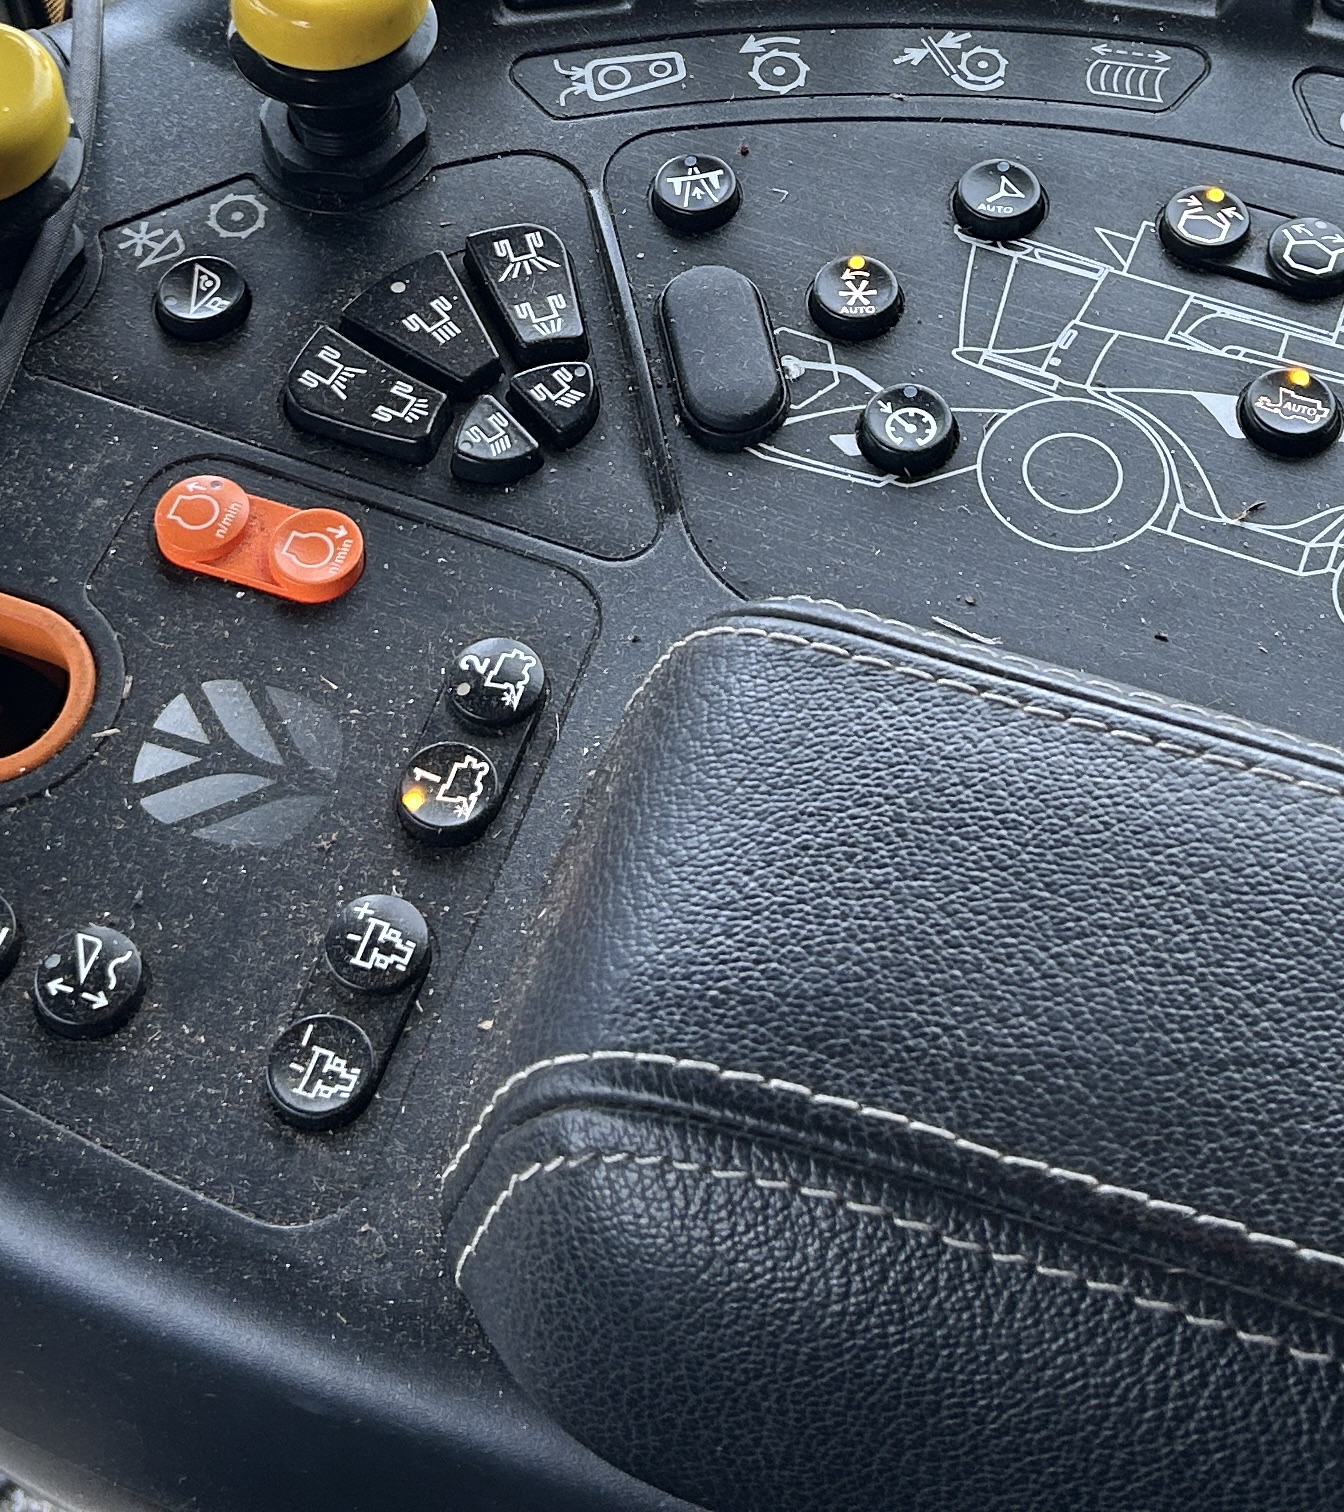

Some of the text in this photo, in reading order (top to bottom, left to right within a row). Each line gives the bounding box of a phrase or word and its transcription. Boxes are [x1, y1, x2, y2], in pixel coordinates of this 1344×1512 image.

[977, 203, 1014, 214] AUTO
[839, 305, 876, 314] AUTO
[1282, 401, 1317, 417] AUTO
[215, 501, 242, 538] n/min
[328, 539, 354, 575] n/min
